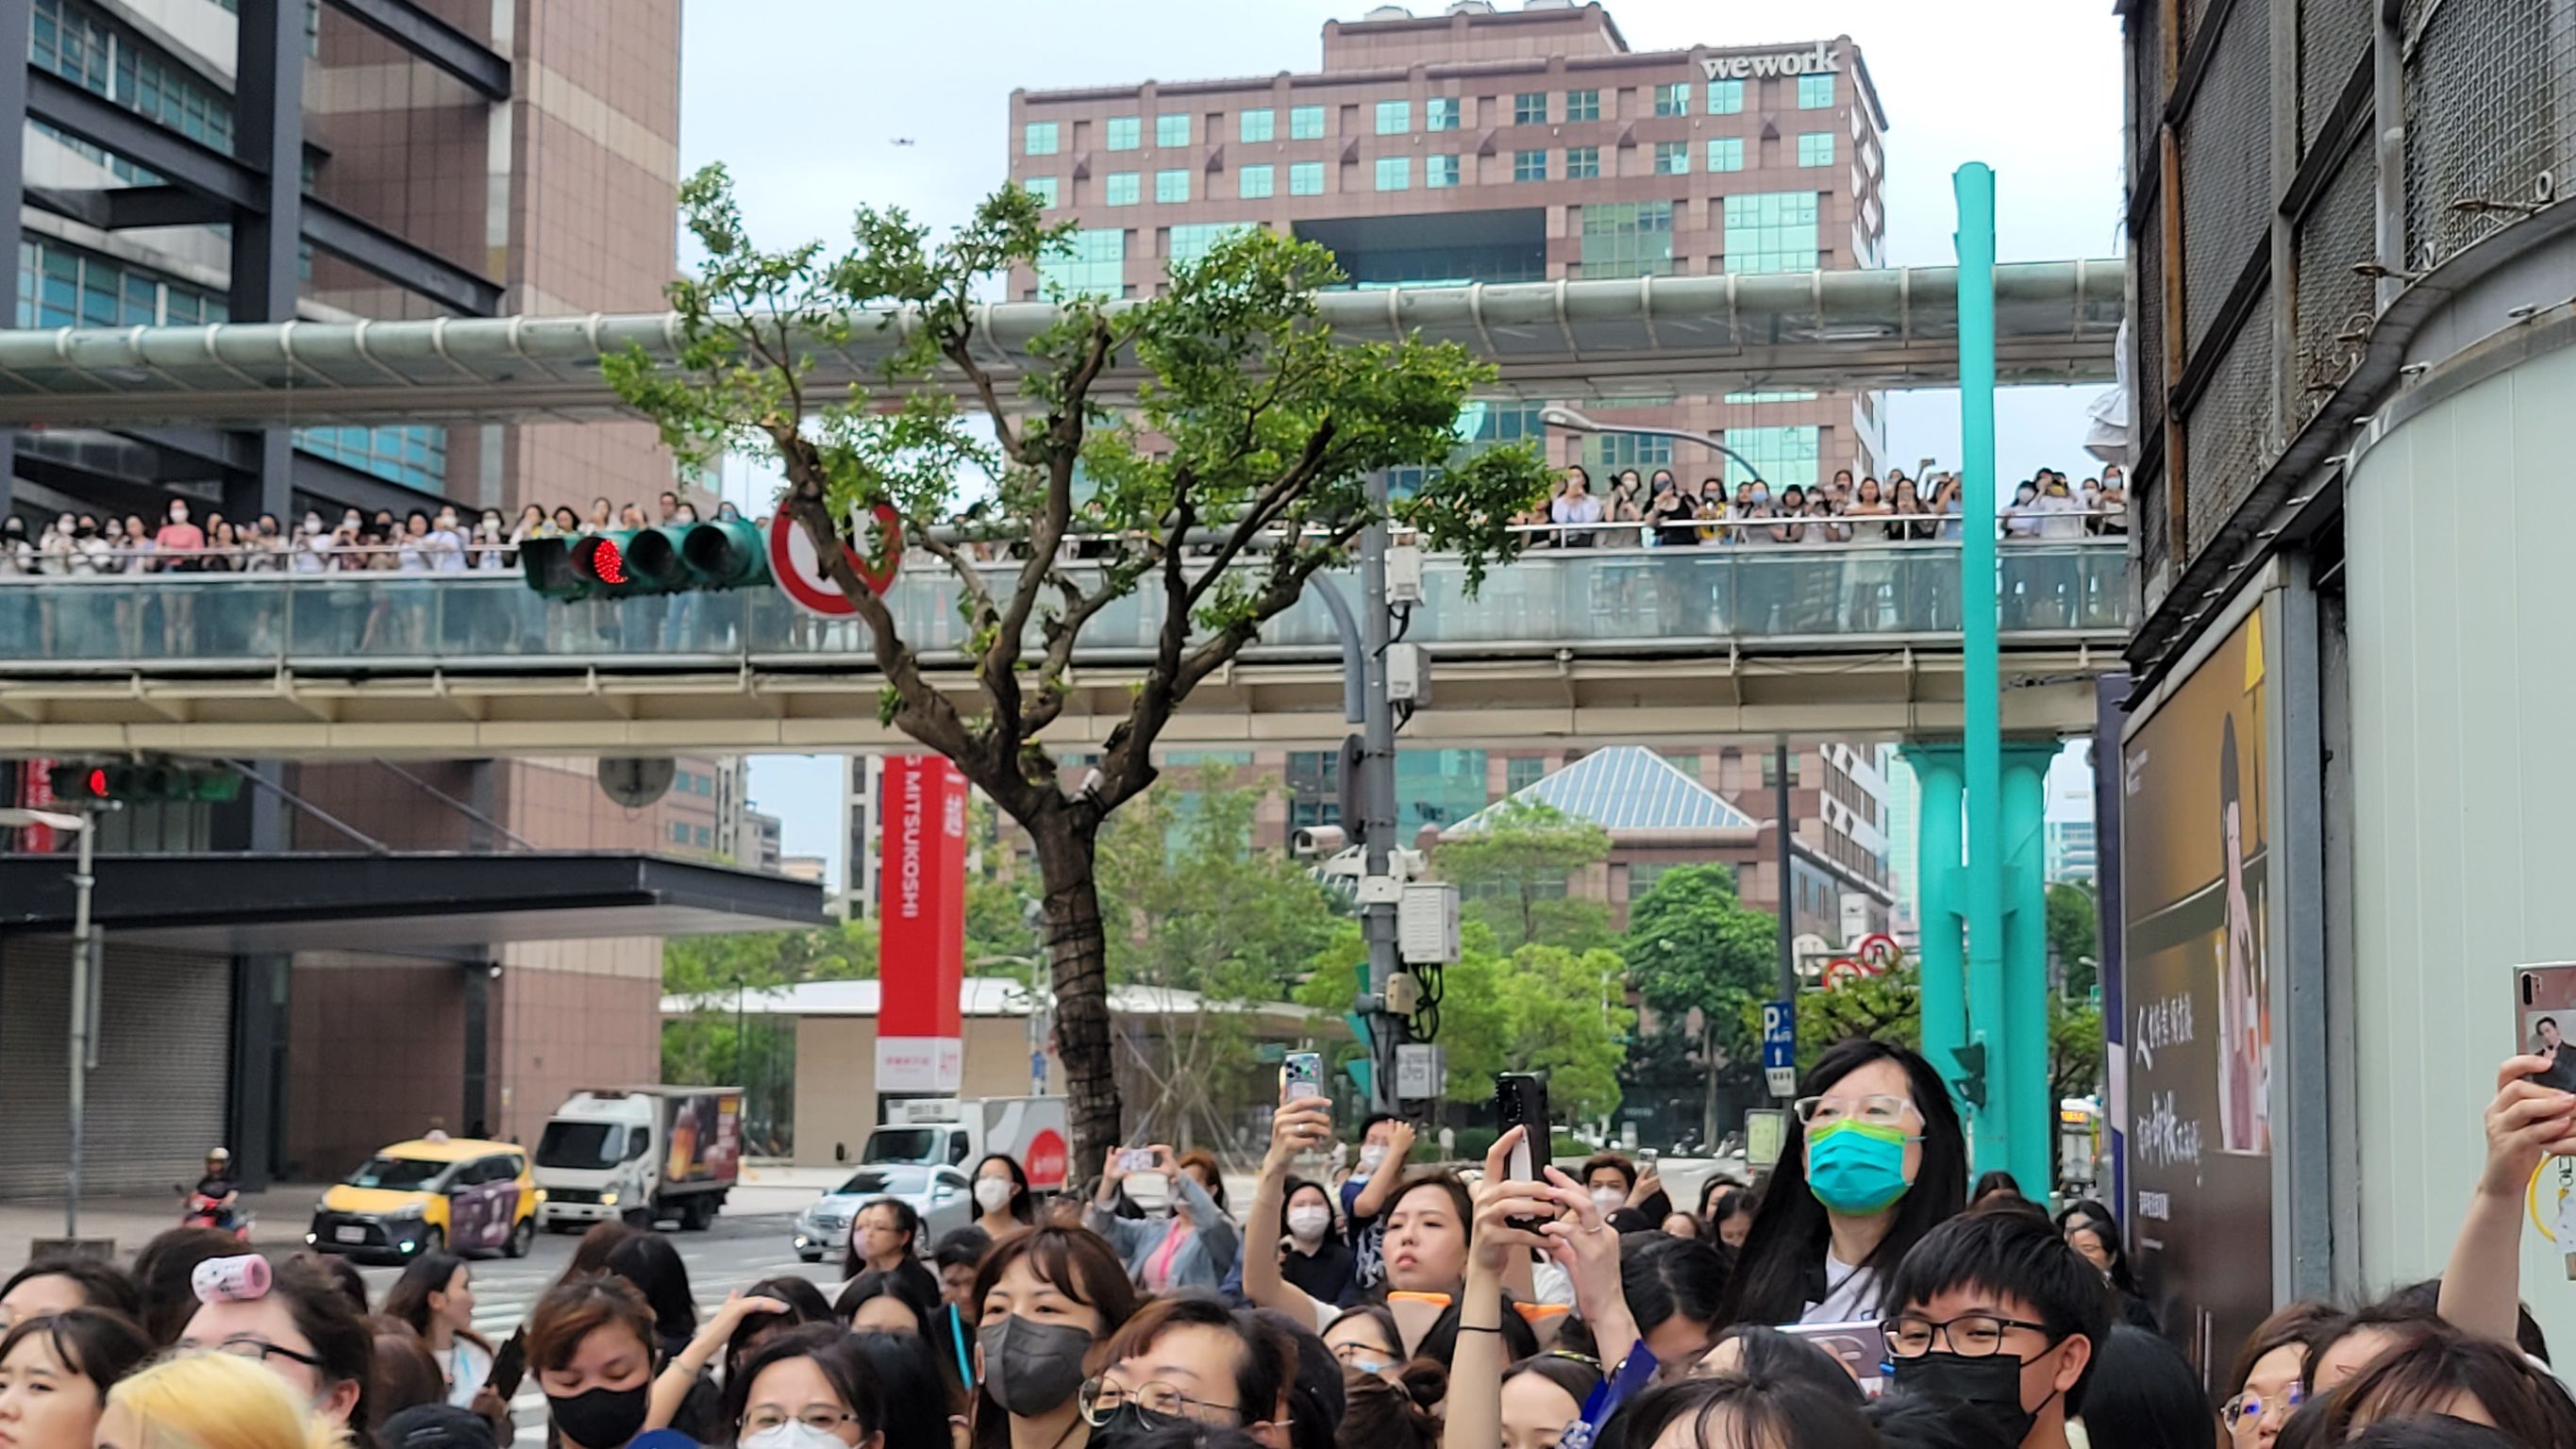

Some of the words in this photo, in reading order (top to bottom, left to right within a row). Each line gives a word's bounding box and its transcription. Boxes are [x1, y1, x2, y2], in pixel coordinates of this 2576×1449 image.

[1700, 42, 1841, 79] wework
[901, 771, 922, 918] MITSUKOSHI
[1764, 1006, 1781, 1042] P
